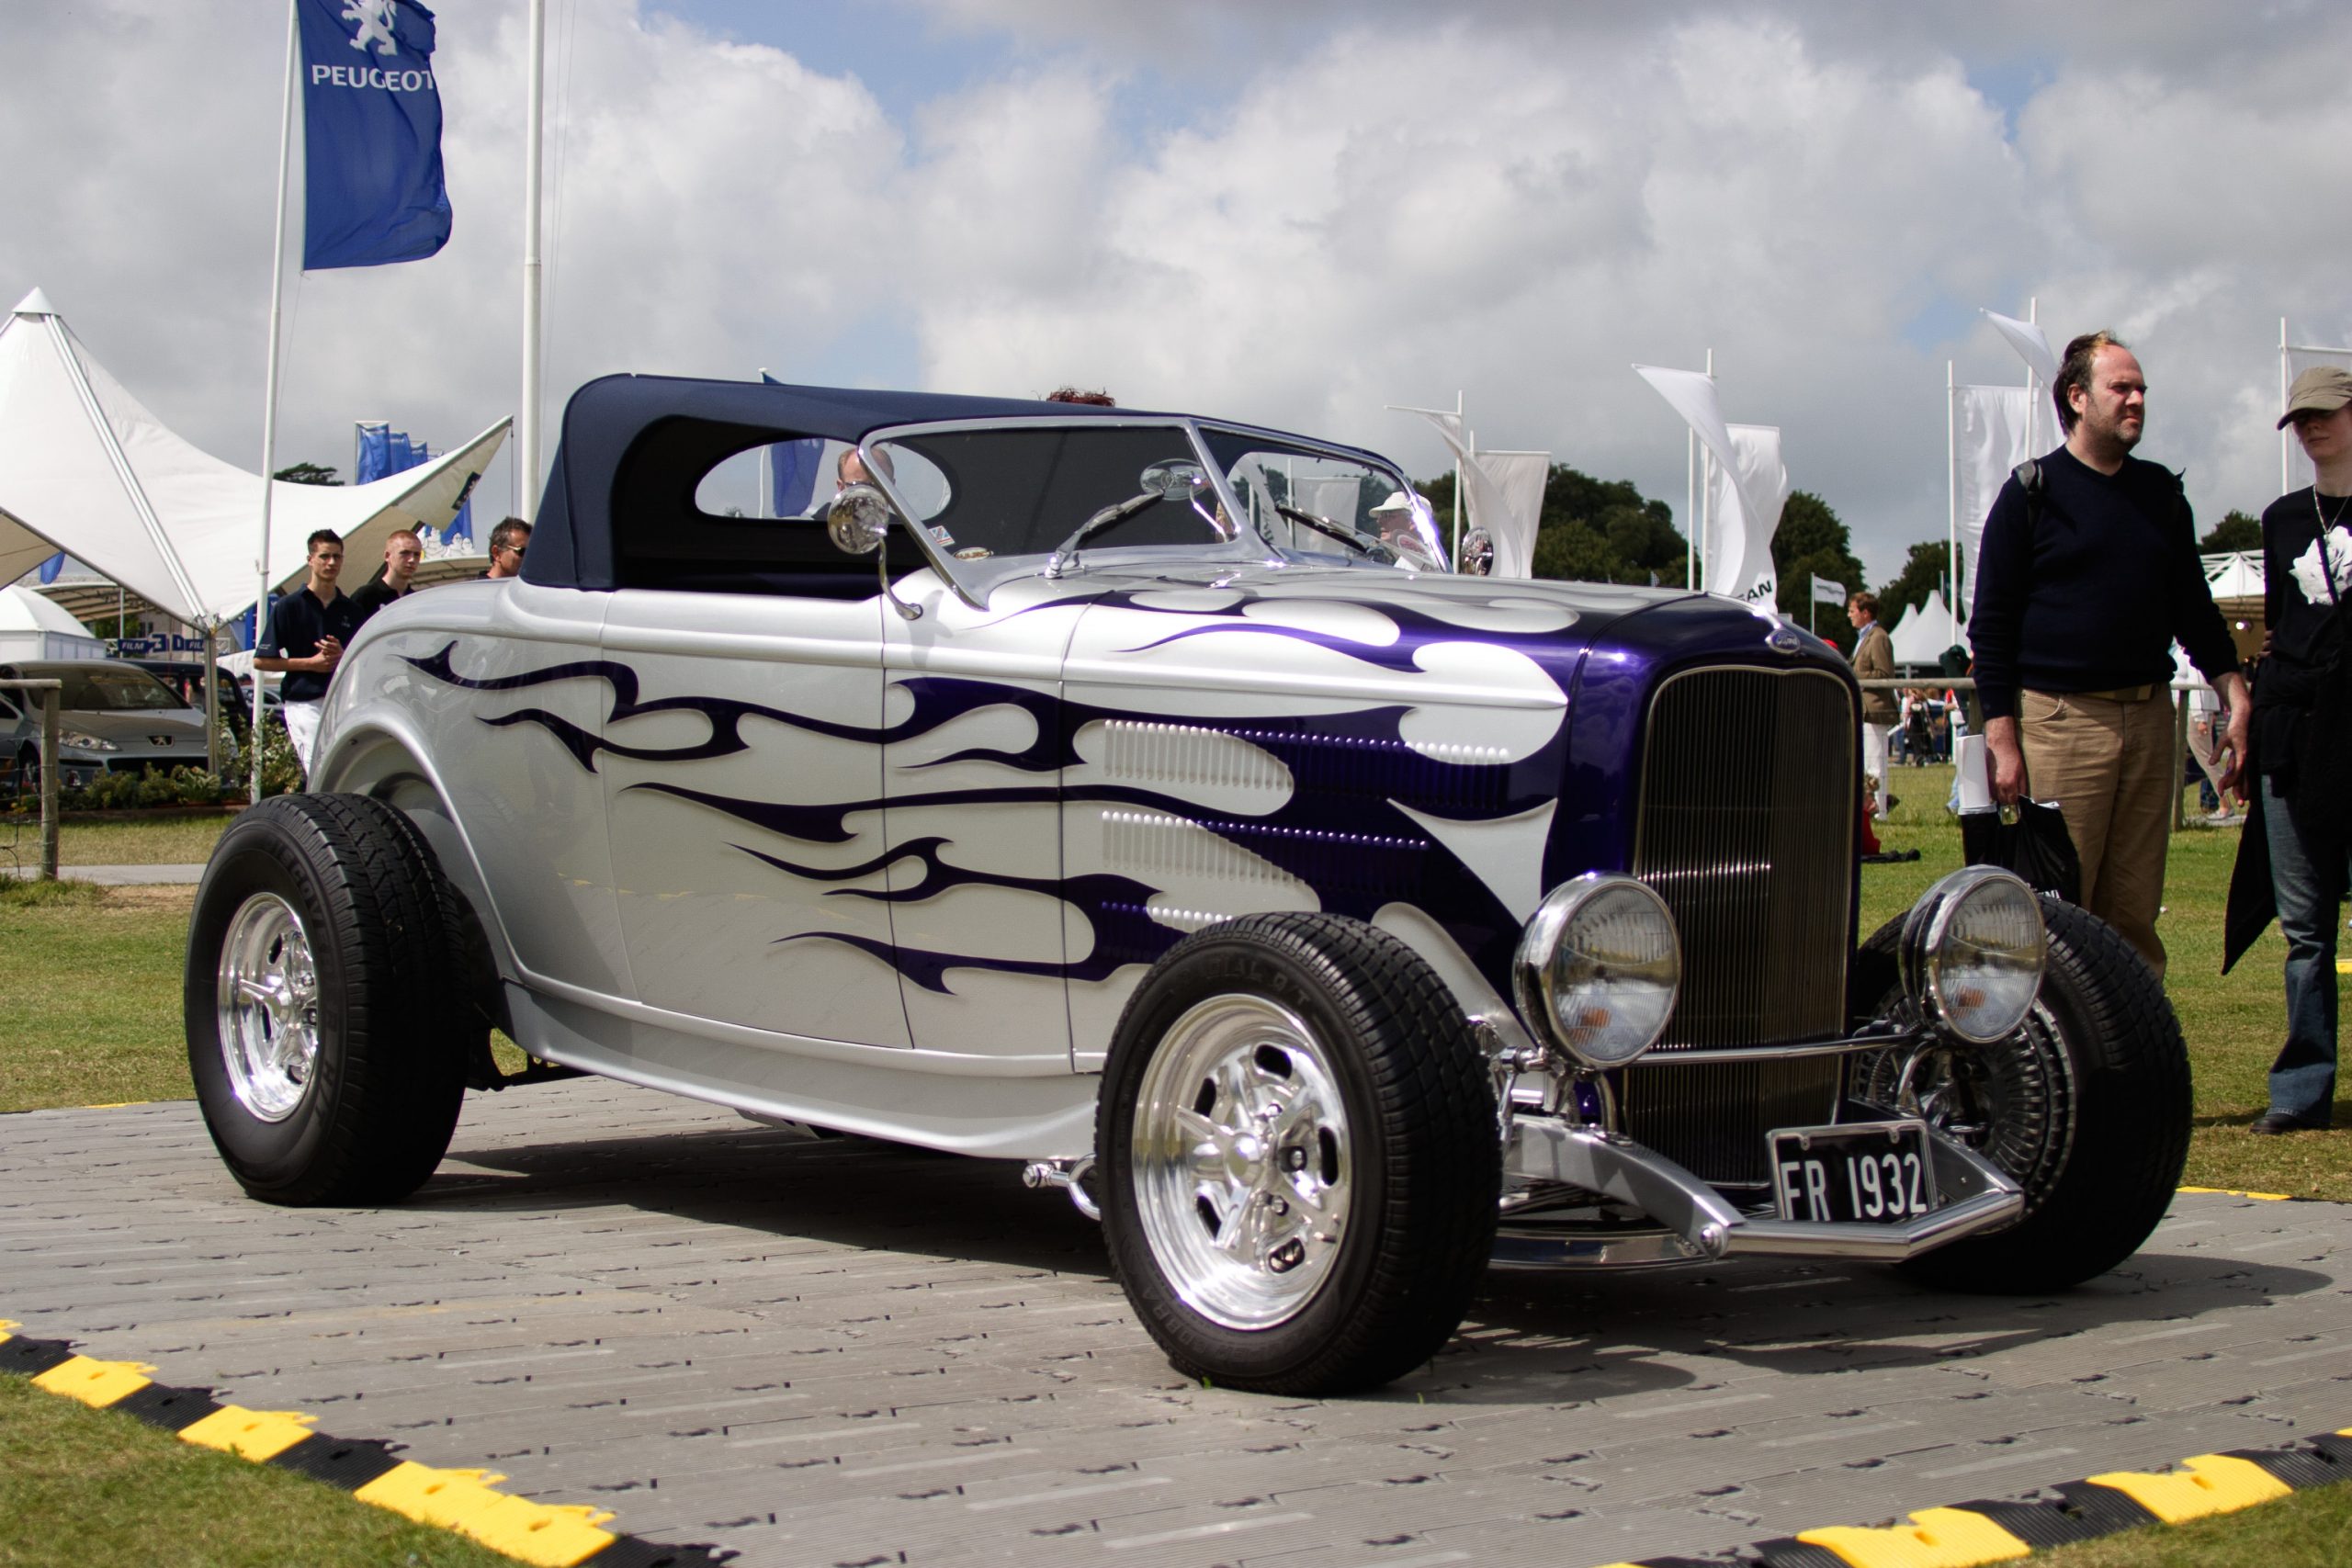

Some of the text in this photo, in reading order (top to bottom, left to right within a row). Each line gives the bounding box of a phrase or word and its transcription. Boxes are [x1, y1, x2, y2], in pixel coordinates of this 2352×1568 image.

[311, 64, 435, 92] PEUGEOT
[121, 640, 144, 650] FILM
[1780, 1152, 1928, 1222] FR 1932
